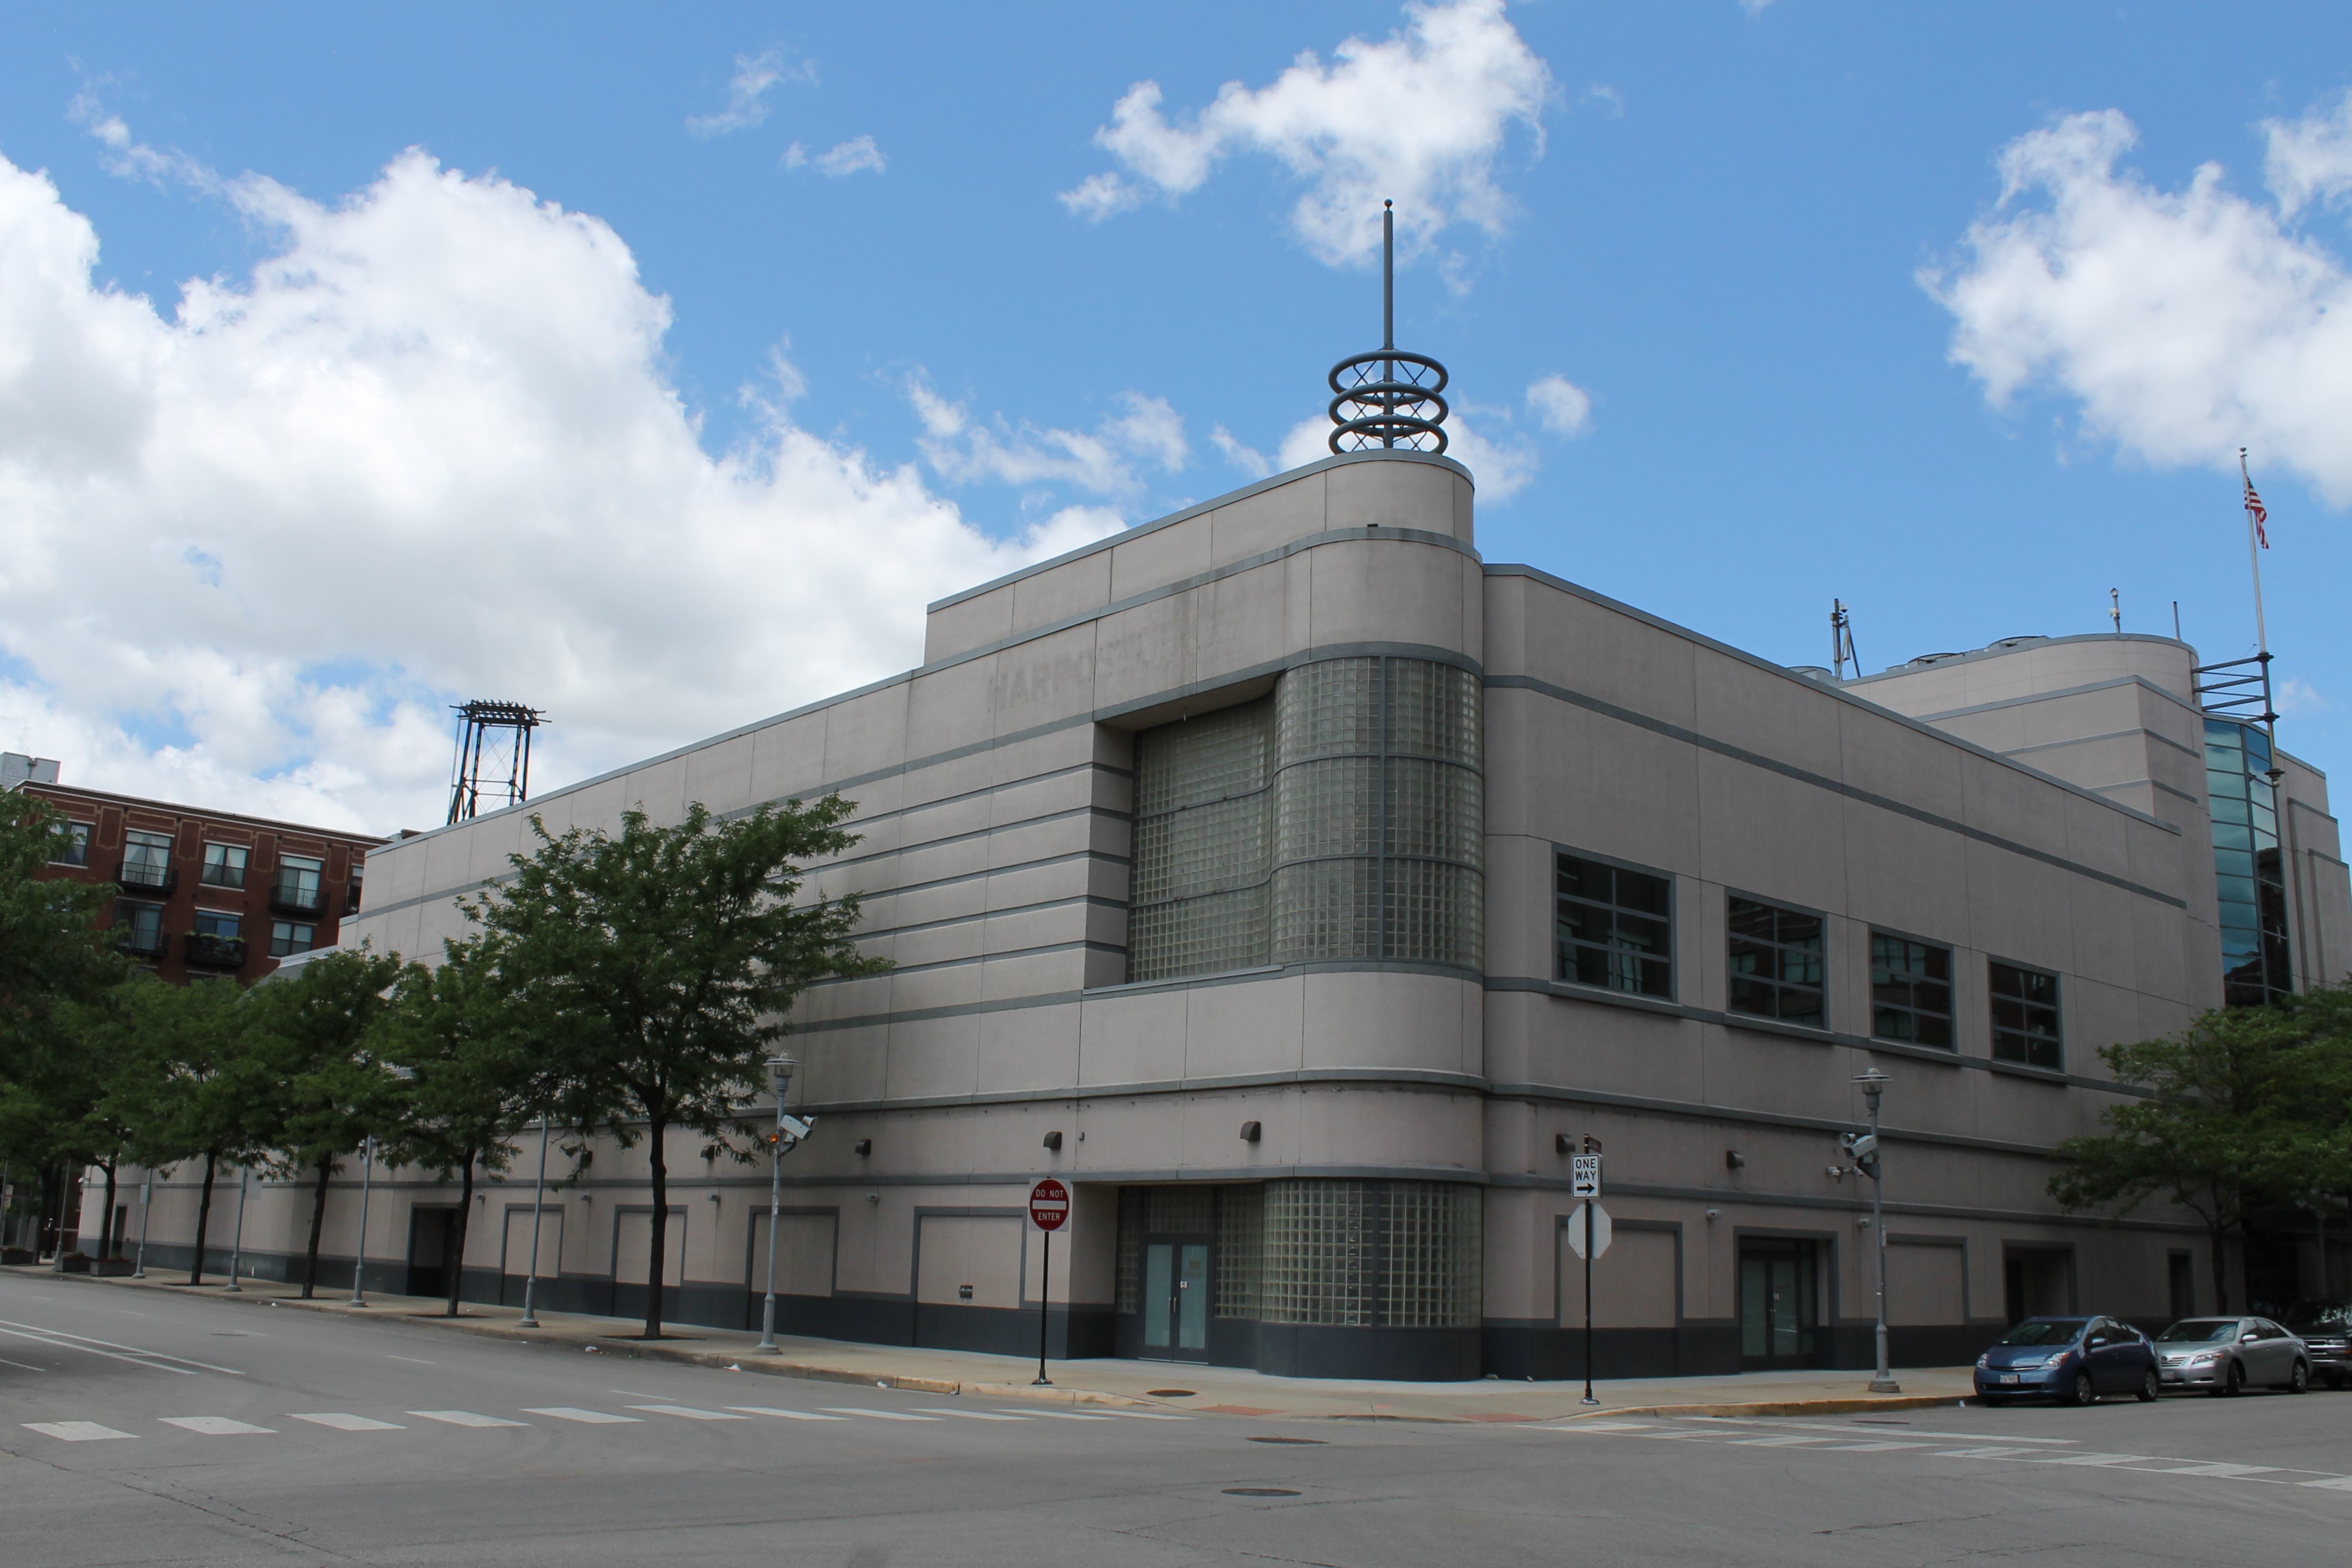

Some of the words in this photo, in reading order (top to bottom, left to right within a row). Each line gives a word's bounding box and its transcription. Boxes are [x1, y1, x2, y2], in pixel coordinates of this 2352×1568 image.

[1575, 1158, 1596, 1169] ONE
[1575, 1170, 1596, 1181] WAY
[1036, 1189, 1045, 1197] DO
[1050, 1190, 1064, 1198] NOT
[1038, 1212, 1060, 1220] ENTER
